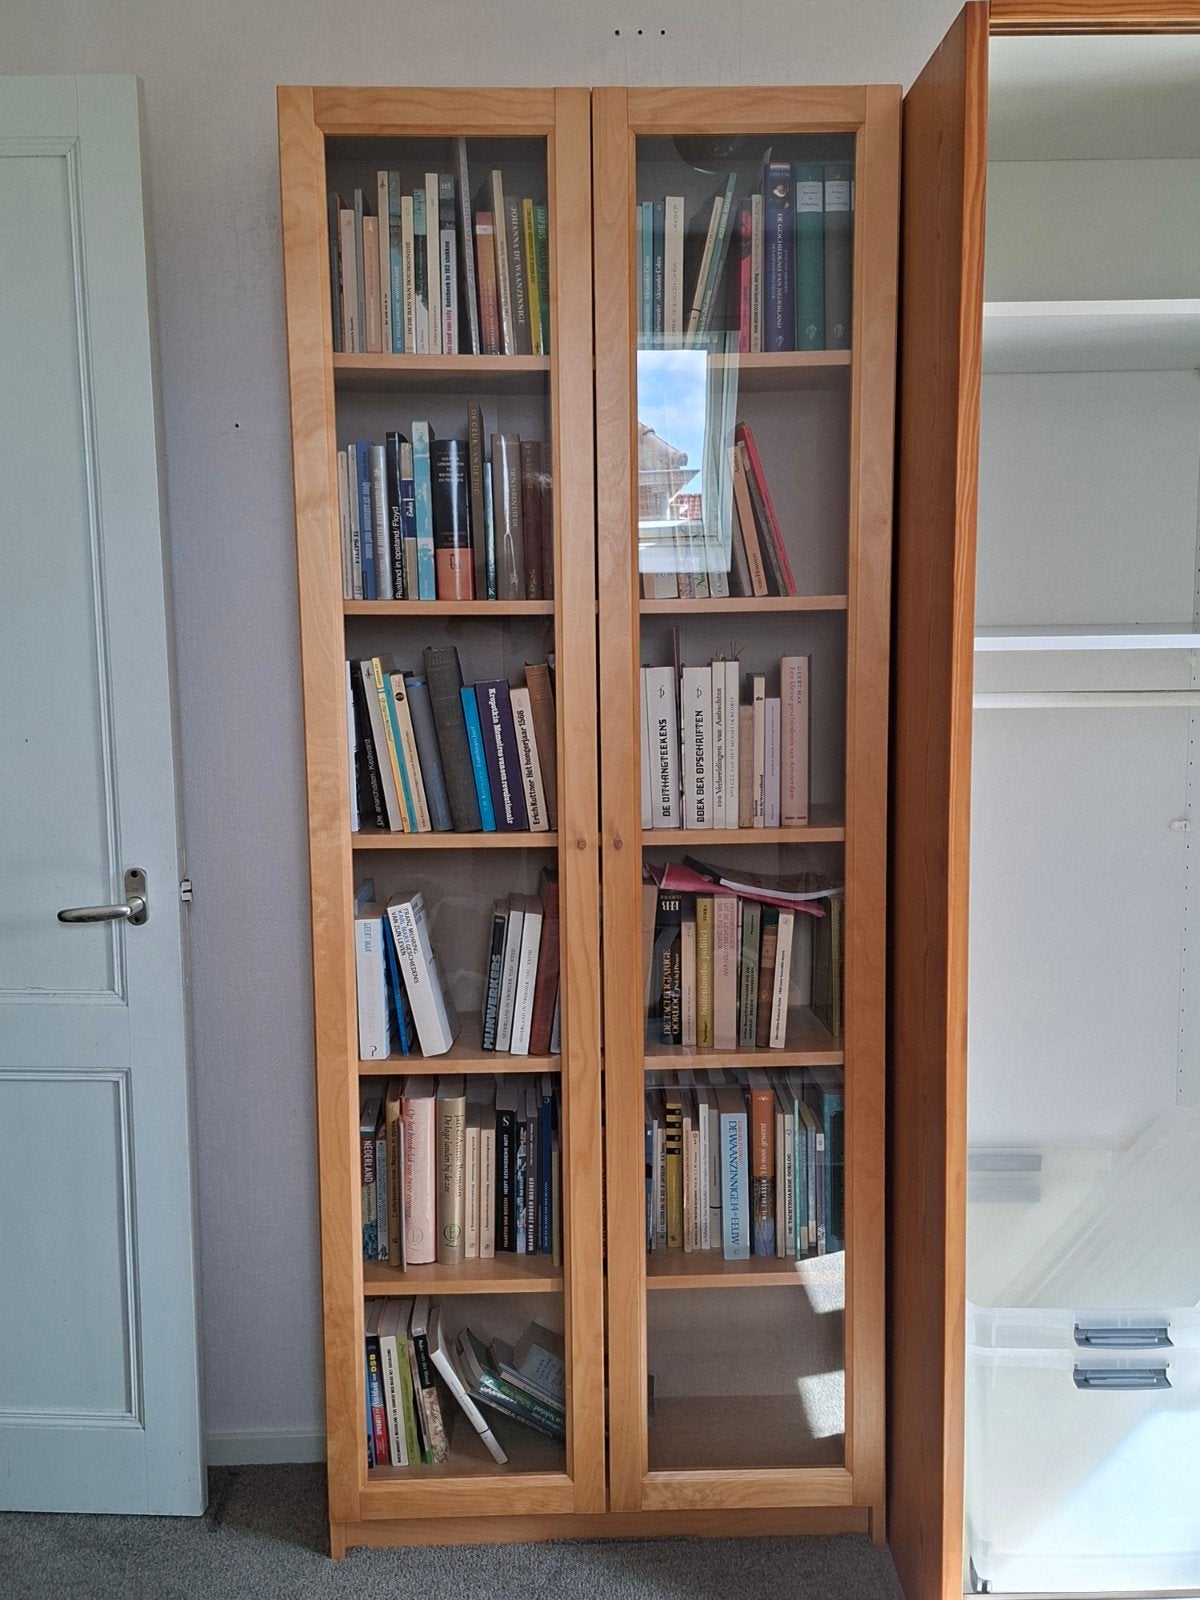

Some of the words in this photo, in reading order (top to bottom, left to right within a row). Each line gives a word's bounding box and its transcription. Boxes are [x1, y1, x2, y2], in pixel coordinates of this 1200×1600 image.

[777, 214, 782, 222] DE
[511, 207, 519, 248] JOHANNA
[514, 251, 520, 262] DE
[514, 264, 525, 325] WAANZINNIGE
[407, 317, 412, 325] DE
[470, 409, 477, 420] DE
[473, 466, 480, 476] DE
[362, 482, 371, 494] Over
[392, 507, 400, 526] Floyd
[364, 532, 373, 542] met
[365, 544, 373, 559] name
[395, 570, 404, 598] Rusland
[488, 688, 499, 723] Kropotkin
[788, 703, 796, 746] geschiedenis
[494, 725, 503, 757] Memoires
[520, 727, 534, 765] hongerjaar
[695, 710, 705, 774] OPSCHRIFTEN
[364, 738, 375, 769] Kedward
[498, 757, 506, 768] van
[658, 718, 670, 802] UITHANGTEEKENS
[525, 766, 534, 778] Het
[715, 745, 723, 794] Verbeeldingen
[528, 780, 538, 806] Kuttner
[695, 777, 705, 795] DER
[502, 781, 514, 824] revolutionair
[662, 805, 671, 817] DE
[696, 799, 705, 822] BOEK
[376, 815, 384, 826] De
[531, 807, 540, 824] Erich
[364, 922, 372, 939] GEERT
[394, 925, 402, 937] ZIJN
[404, 908, 412, 927] FRANZ
[408, 928, 418, 954] MEHRING
[365, 941, 373, 952] MAK
[397, 910, 405, 925] KARL
[401, 926, 409, 943] MARX
[406, 944, 419, 984] GESCHIEDENIS
[397, 938, 406, 956] LEVEN
[700, 930, 708, 959] politici
[663, 949, 671, 1021] TACHTIGJARIGE
[700, 962, 708, 1015] buitenlandse
[484, 954, 501, 1049] MIJNWERKERS
[663, 1022, 671, 1034] DE
[408, 1109, 416, 1120] Op
[444, 1115, 452, 1125] De
[455, 1115, 463, 1128] Jan
[408, 1121, 416, 1132] het
[444, 1126, 452, 1140] lage
[728, 1121, 737, 1133] DE
[760, 1123, 768, 1147] geweest
[407, 1133, 415, 1162] breukvlak
[444, 1142, 452, 1162] landen
[364, 1140, 373, 1182] NEDERLAND
[443, 1164, 452, 1173] bij
[729, 1133, 738, 1202] WAANZINNIGE
[445, 1174, 451, 1182] de
[731, 1218, 739, 1245] EEUW
[788, 1226, 792, 1234] DE
[423, 1371, 431, 1384] Woud
